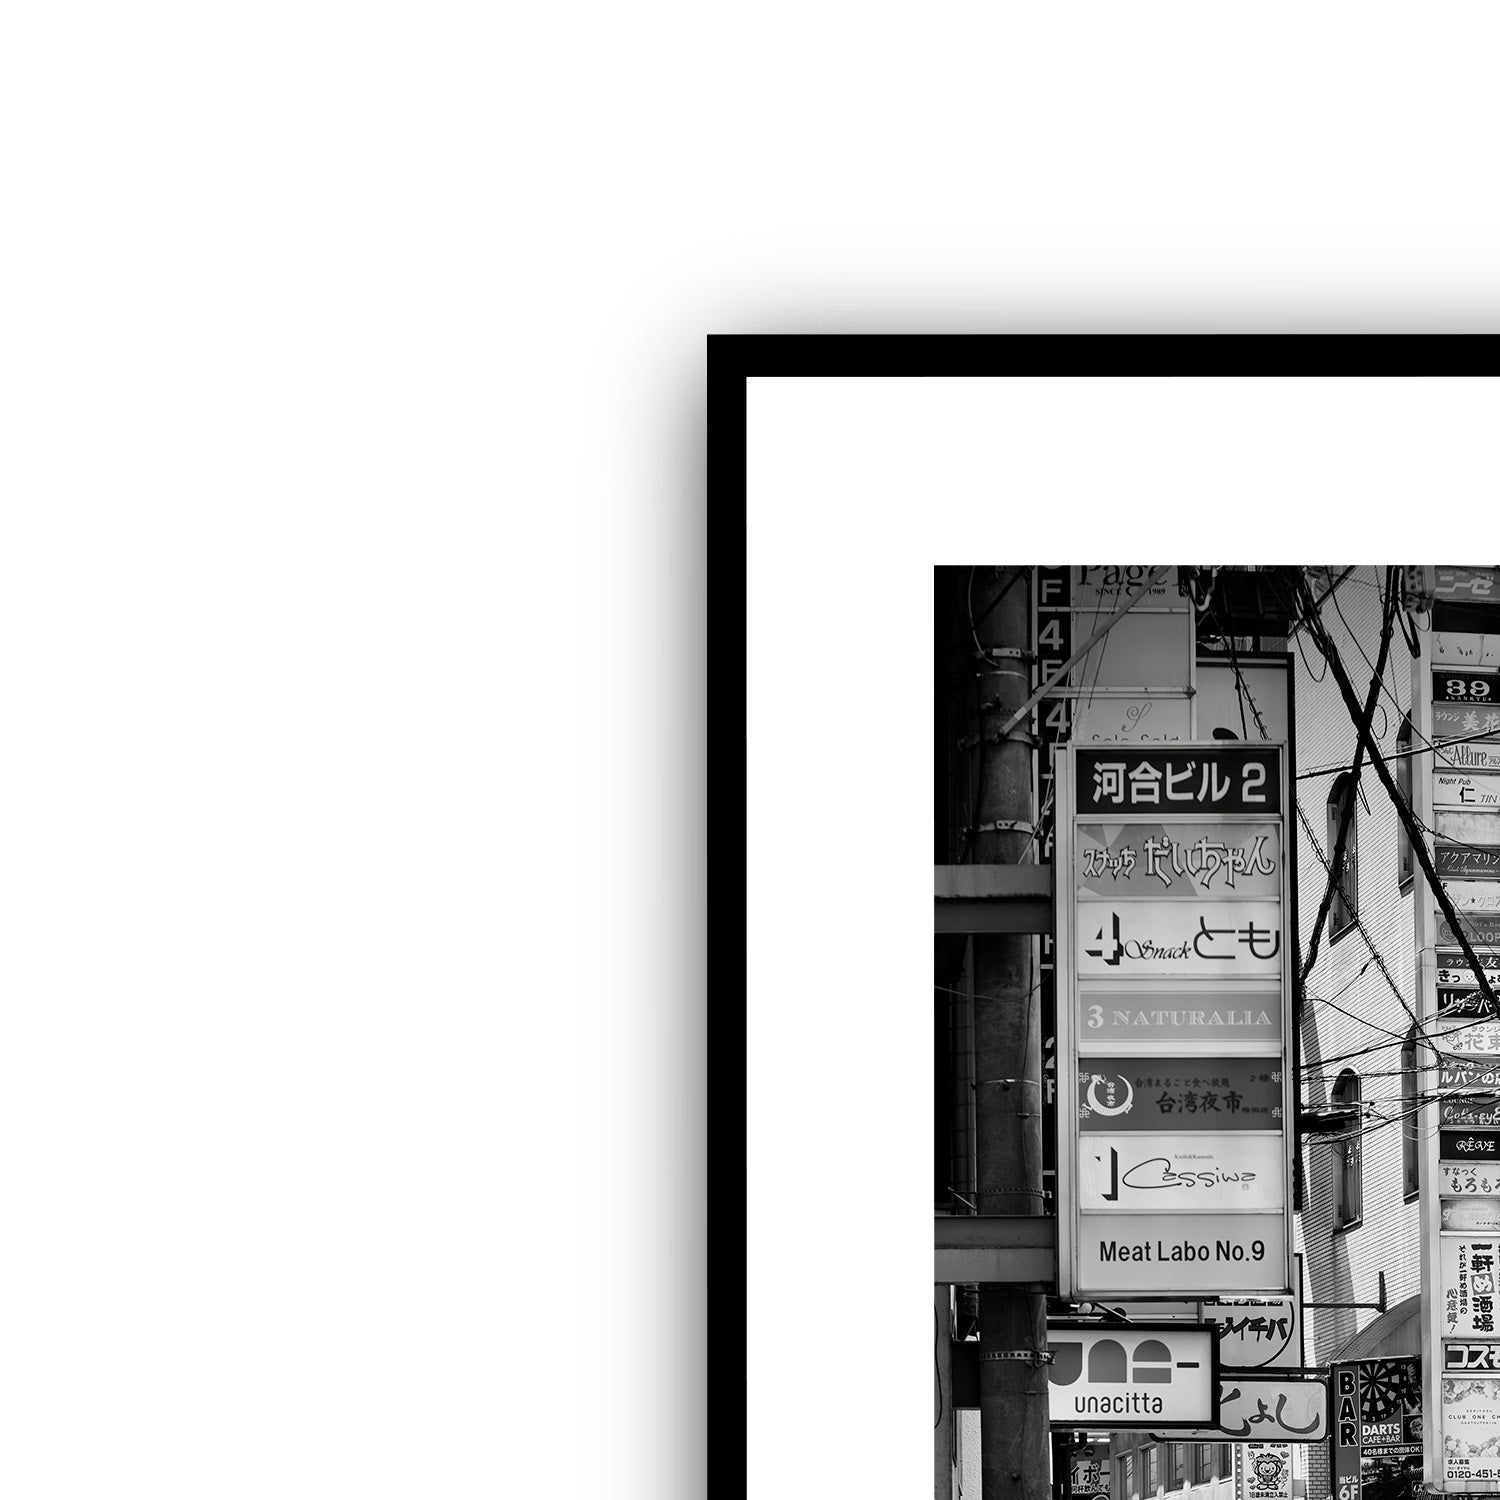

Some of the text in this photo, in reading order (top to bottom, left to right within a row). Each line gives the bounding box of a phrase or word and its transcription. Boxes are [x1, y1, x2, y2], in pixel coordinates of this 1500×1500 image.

[1147, 587, 1166, 596] 1989
[1446, 679, 1491, 697] 39
[1450, 744, 1488, 767] Allure
[1091, 762, 1266, 806] 河合ビル 2
[1438, 777, 1472, 786] Night Pub
[1480, 794, 1498, 804] TIN
[1142, 835, 1276, 889] だいちゃん
[1084, 911, 1281, 966] 4 Snack とも
[1086, 1005, 1275, 1030] 3 NATURALIA
[1154, 1090, 1244, 1115] 台湾夜市
[1094, 1146, 1119, 1202] 1
[1442, 1167, 1478, 1177] すなっく
[1099, 1239, 1266, 1263] Meat Labo No.9
[1470, 1243, 1495, 1333] 一軒め酒場
[1073, 1391, 1163, 1415] unacitta
[1338, 1370, 1359, 1447] BAR
[1361, 1423, 1401, 1437] DARTS
[1338, 1485, 1359, 1500] 6F
